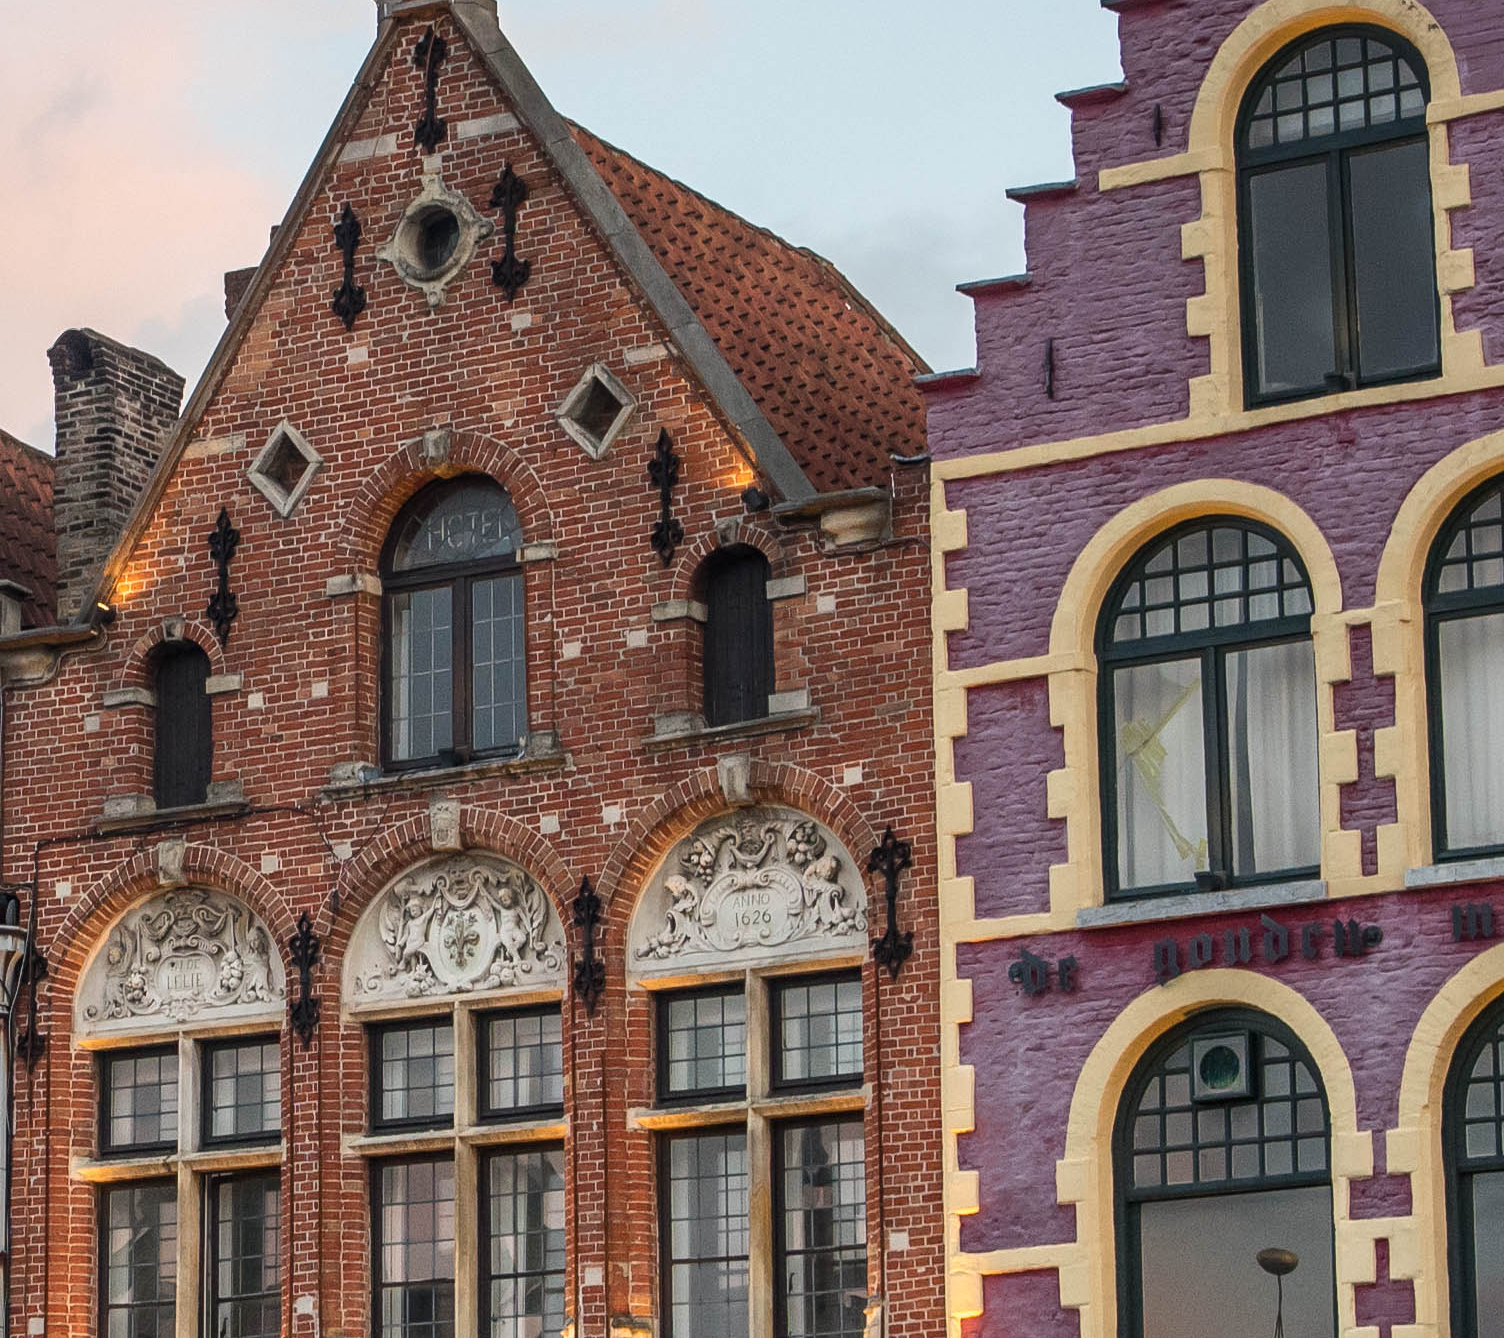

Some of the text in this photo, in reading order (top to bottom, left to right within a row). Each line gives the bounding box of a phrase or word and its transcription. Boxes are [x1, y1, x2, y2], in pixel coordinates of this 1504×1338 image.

[732, 892, 771, 910] ANNO
[735, 909, 772, 928] 1626
[1020, 947, 1079, 996] de
[1152, 913, 1364, 987] gouden
